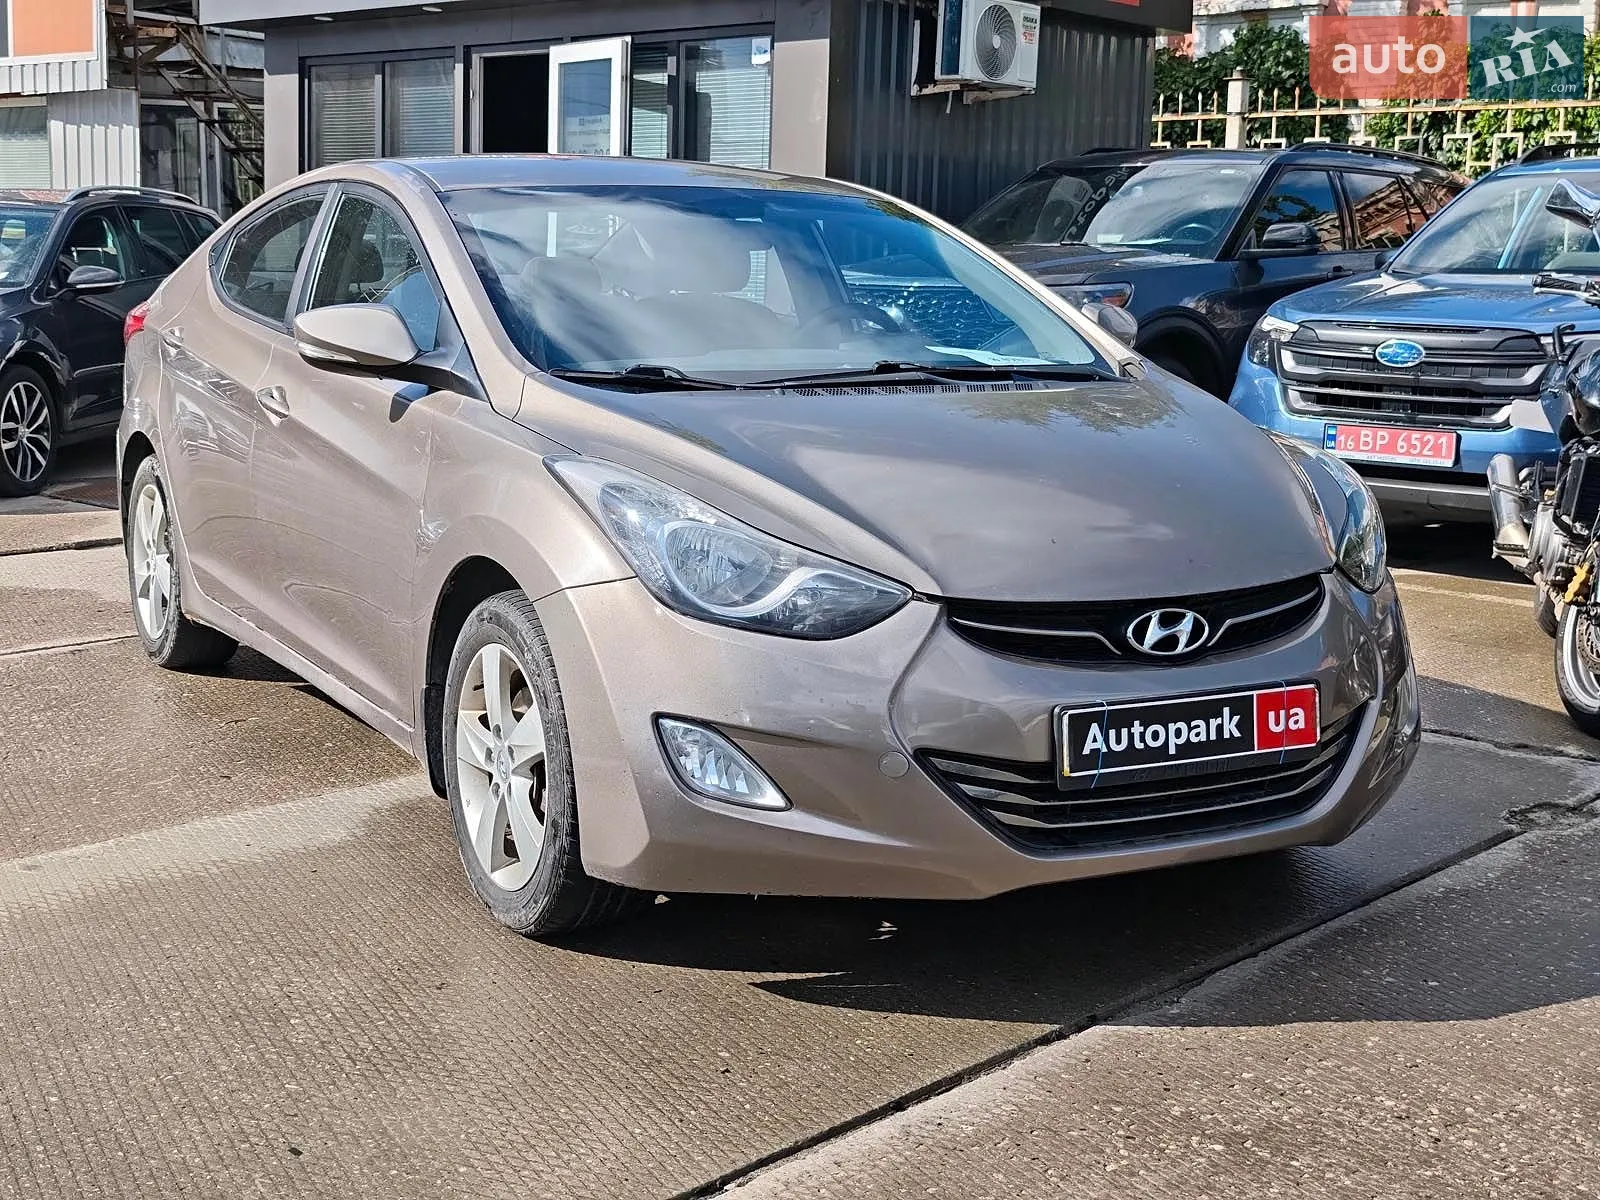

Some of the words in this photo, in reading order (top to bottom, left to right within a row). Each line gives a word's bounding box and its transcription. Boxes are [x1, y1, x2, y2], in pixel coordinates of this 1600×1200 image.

[1326, 440, 1335, 448] UA
[1338, 433, 1355, 450] 16
[1360, 430, 1389, 451] BP
[1396, 432, 1449, 457] 6521
[1082, 707, 1242, 755] Autopark
[1268, 707, 1306, 733] ua
